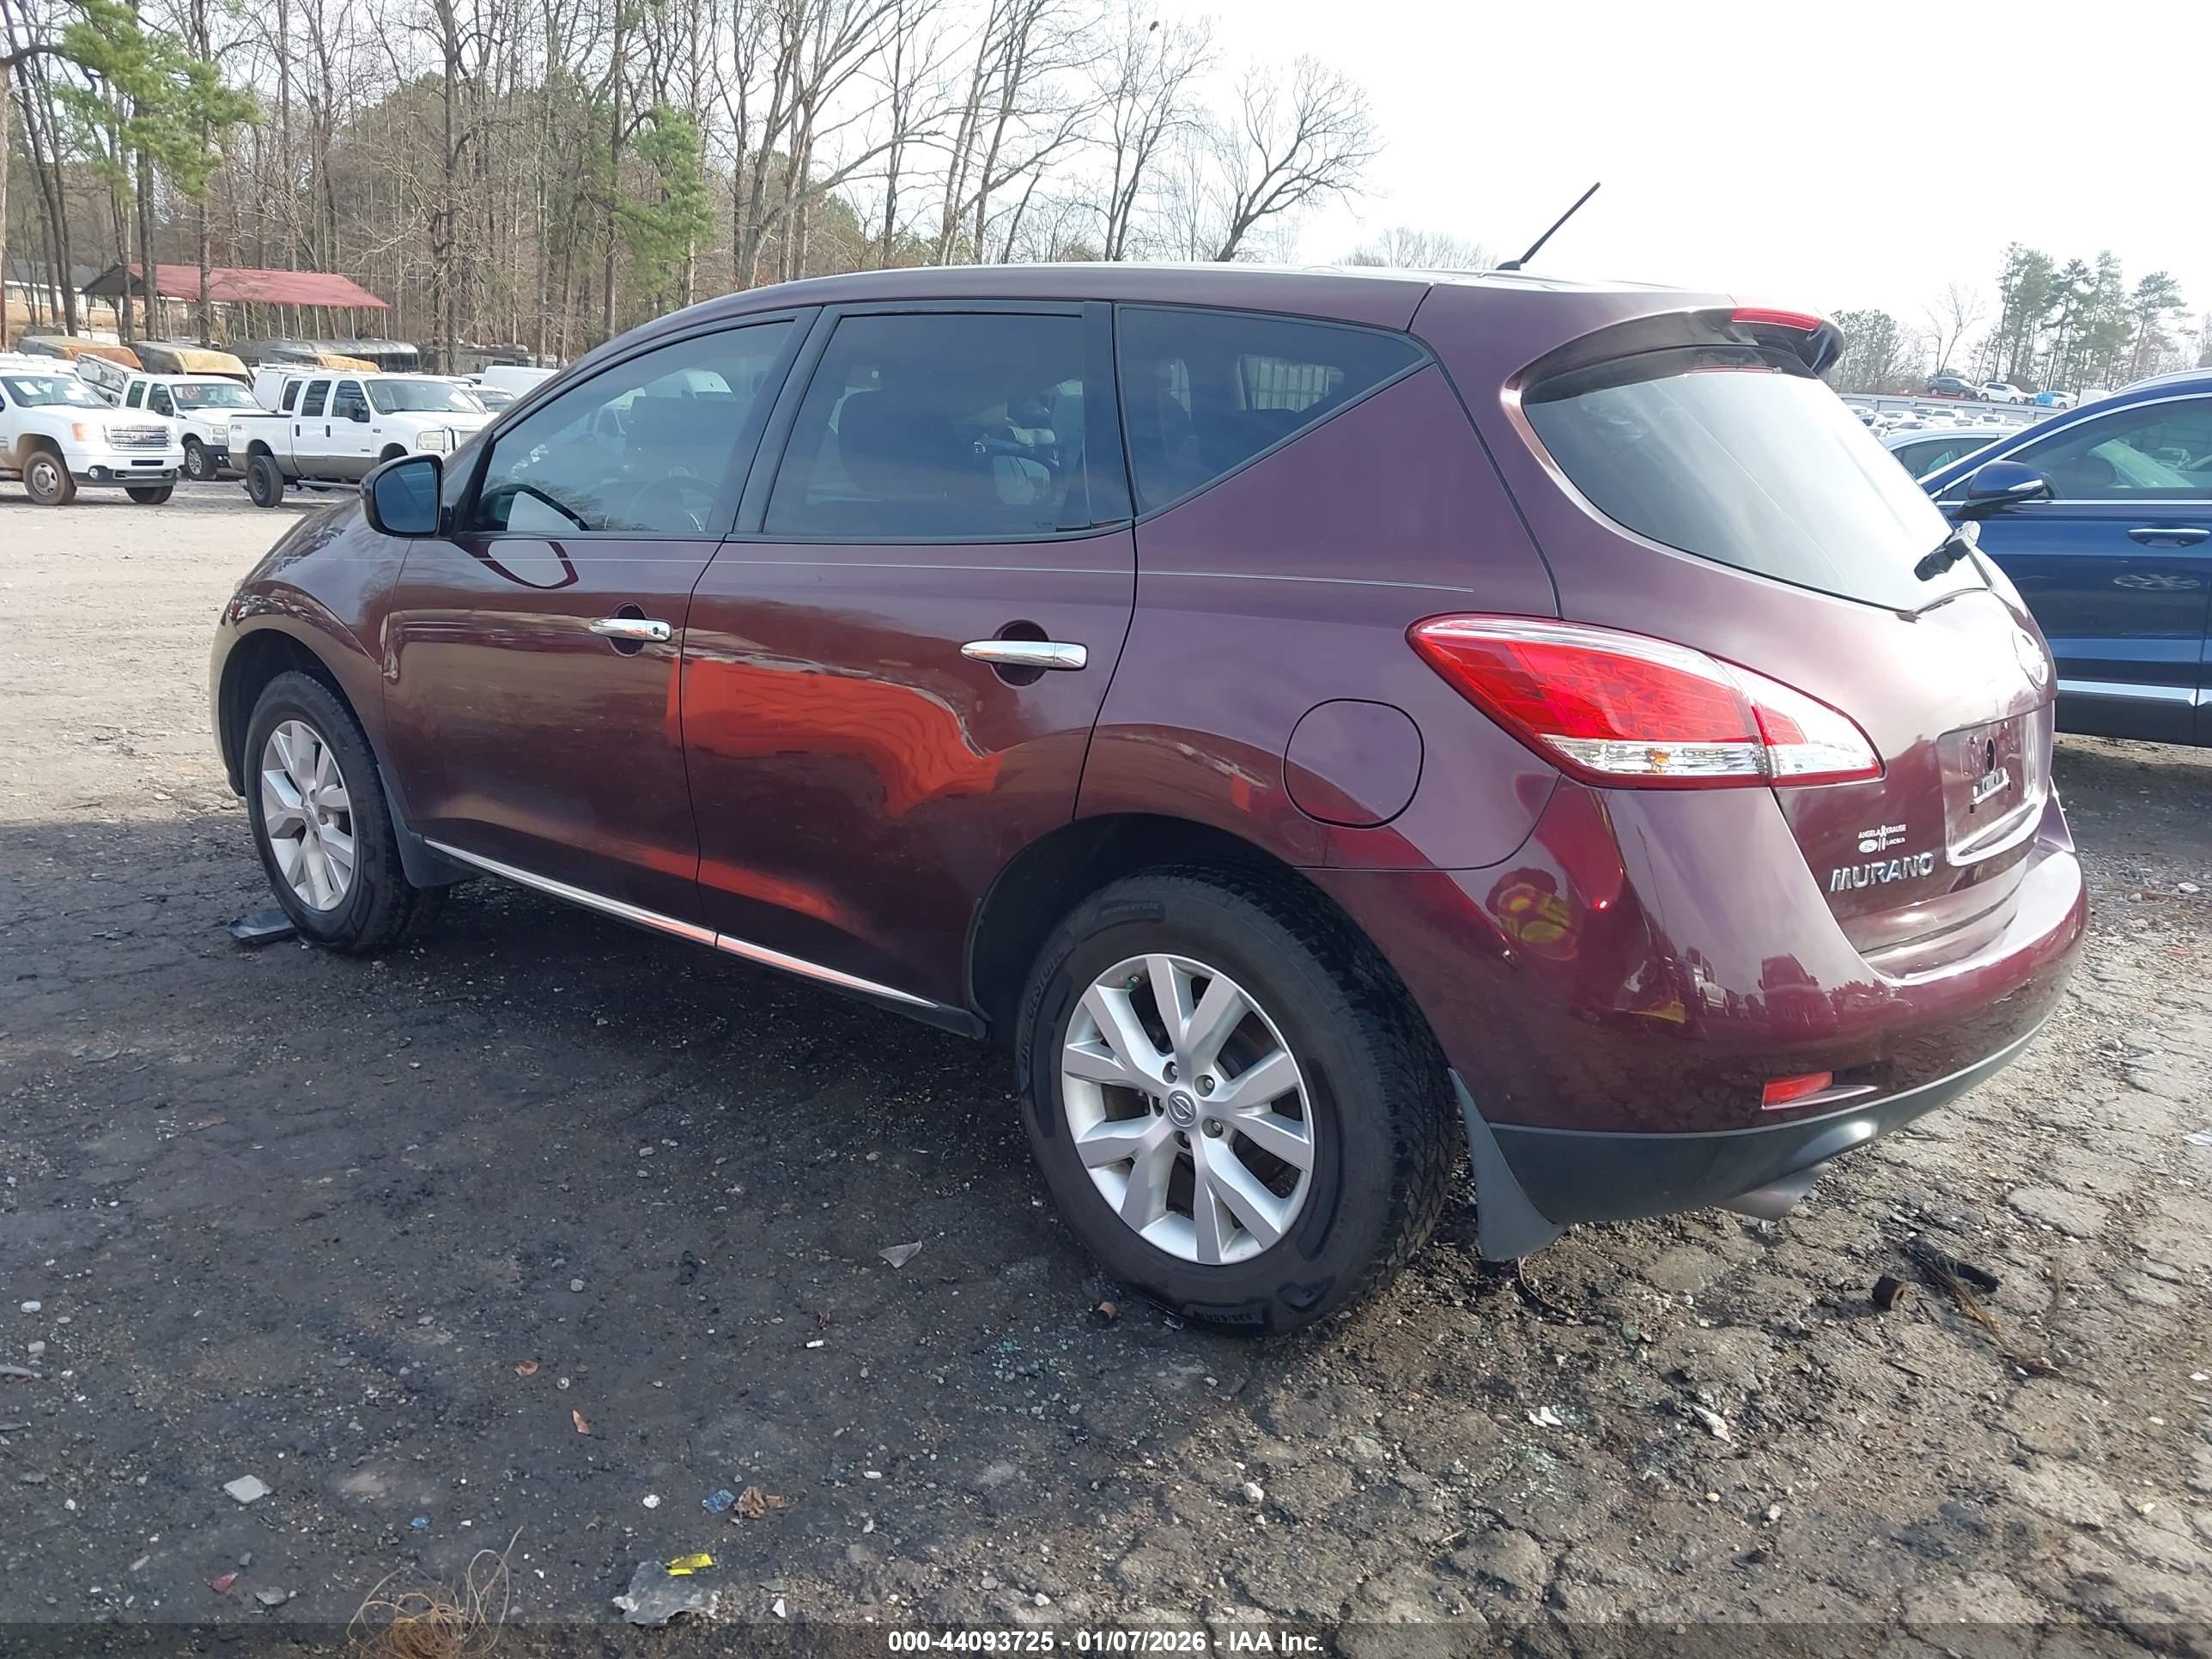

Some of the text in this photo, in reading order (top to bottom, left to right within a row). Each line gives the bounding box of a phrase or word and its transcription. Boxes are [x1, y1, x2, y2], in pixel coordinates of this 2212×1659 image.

[1858, 823, 1907, 839] ANGELA KRAUSE
[1830, 851, 1935, 892] MURANO
